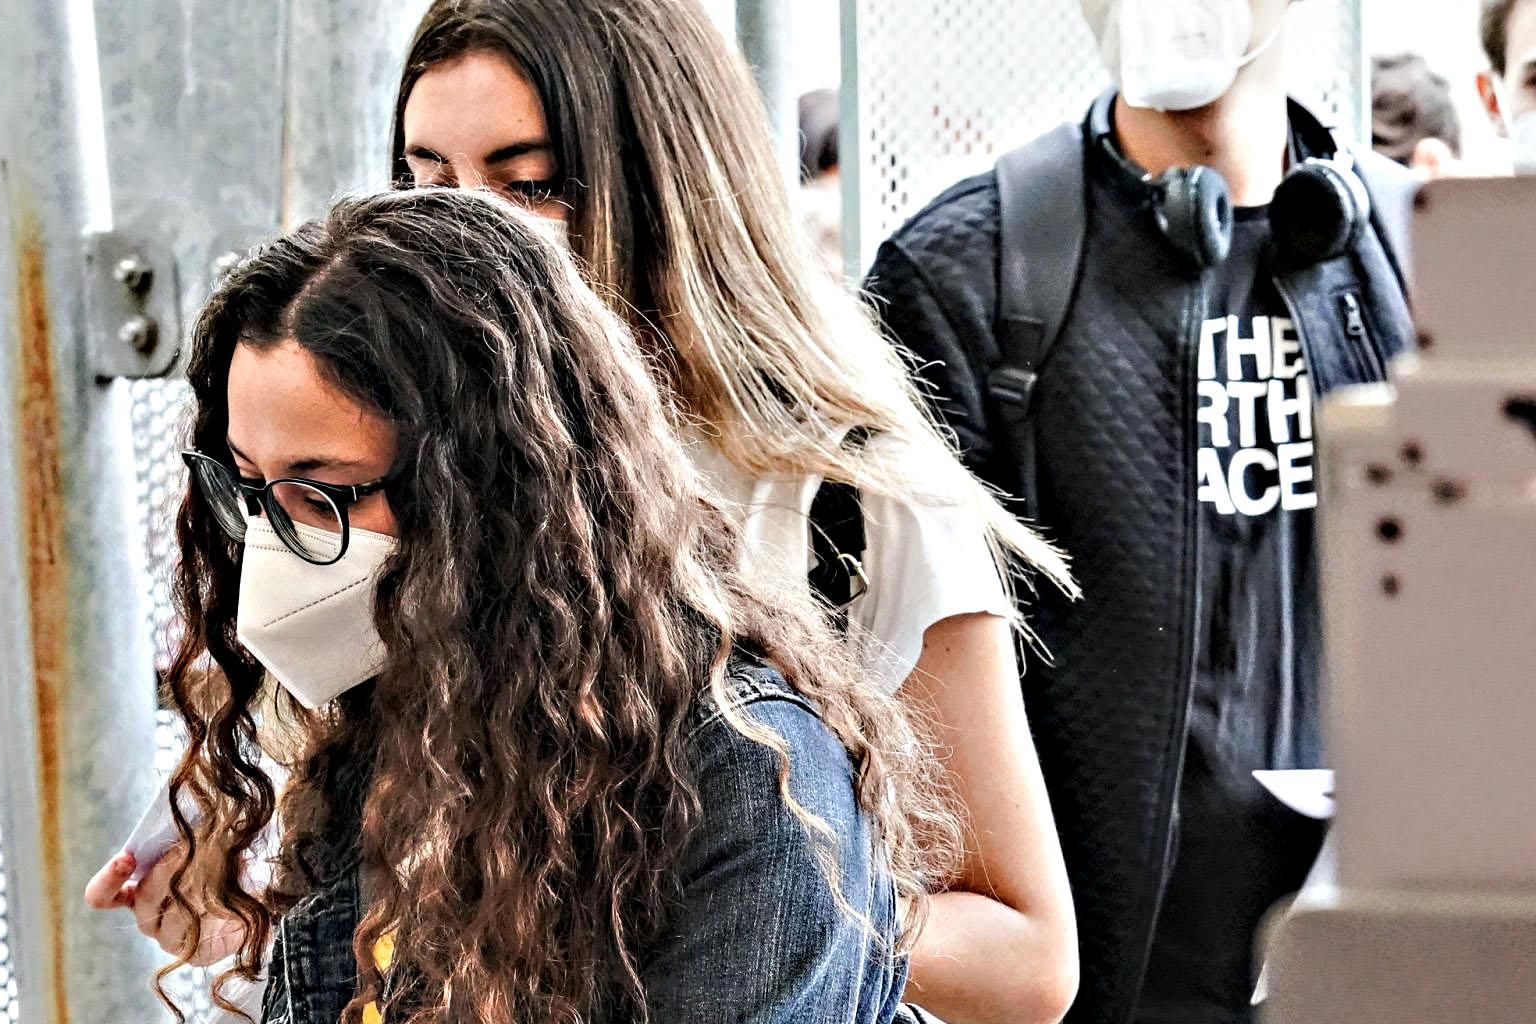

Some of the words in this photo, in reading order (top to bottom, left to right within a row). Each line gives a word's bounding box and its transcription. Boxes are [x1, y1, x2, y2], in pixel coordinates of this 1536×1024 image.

[1197, 315, 1307, 379] THE
[1197, 375, 1312, 447] RTH
[1197, 441, 1317, 516] ACE
